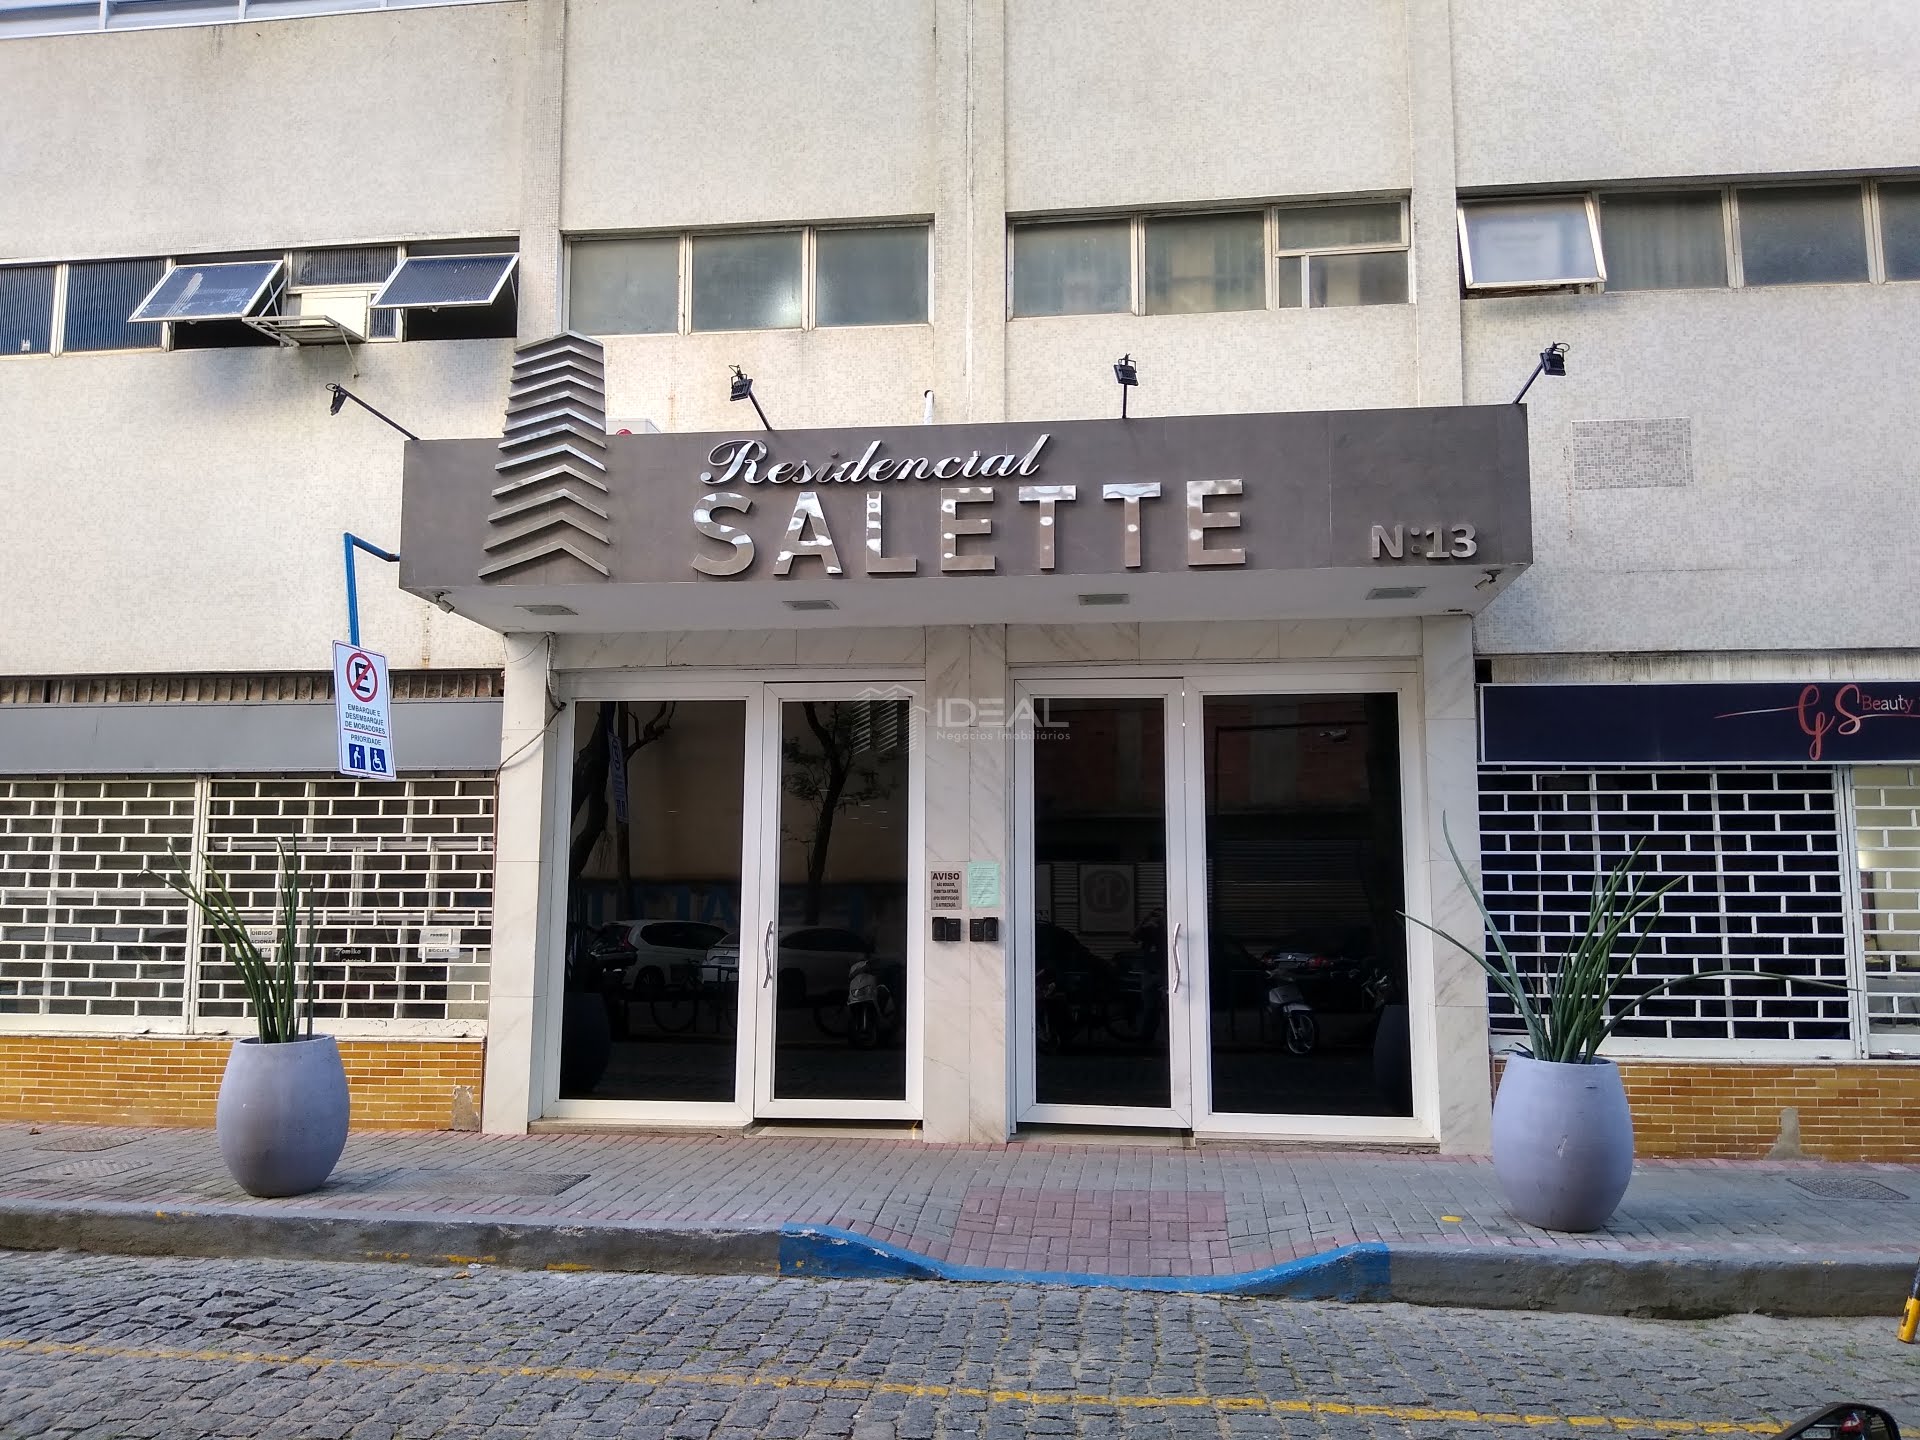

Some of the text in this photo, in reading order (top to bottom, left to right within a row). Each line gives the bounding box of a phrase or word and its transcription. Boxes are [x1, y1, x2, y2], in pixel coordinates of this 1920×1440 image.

[700, 433, 1051, 485] Residencial
[690, 477, 1247, 576] SALETTE
[347, 703, 377, 717] EMBARQUE
[1862, 694, 1913, 714] Beauty
[345, 711, 384, 726] DESEMBARQUE
[344, 720, 386, 735] DE MORADORES
[350, 733, 382, 746] PRIORIDADE
[932, 872, 960, 881] AVISO
